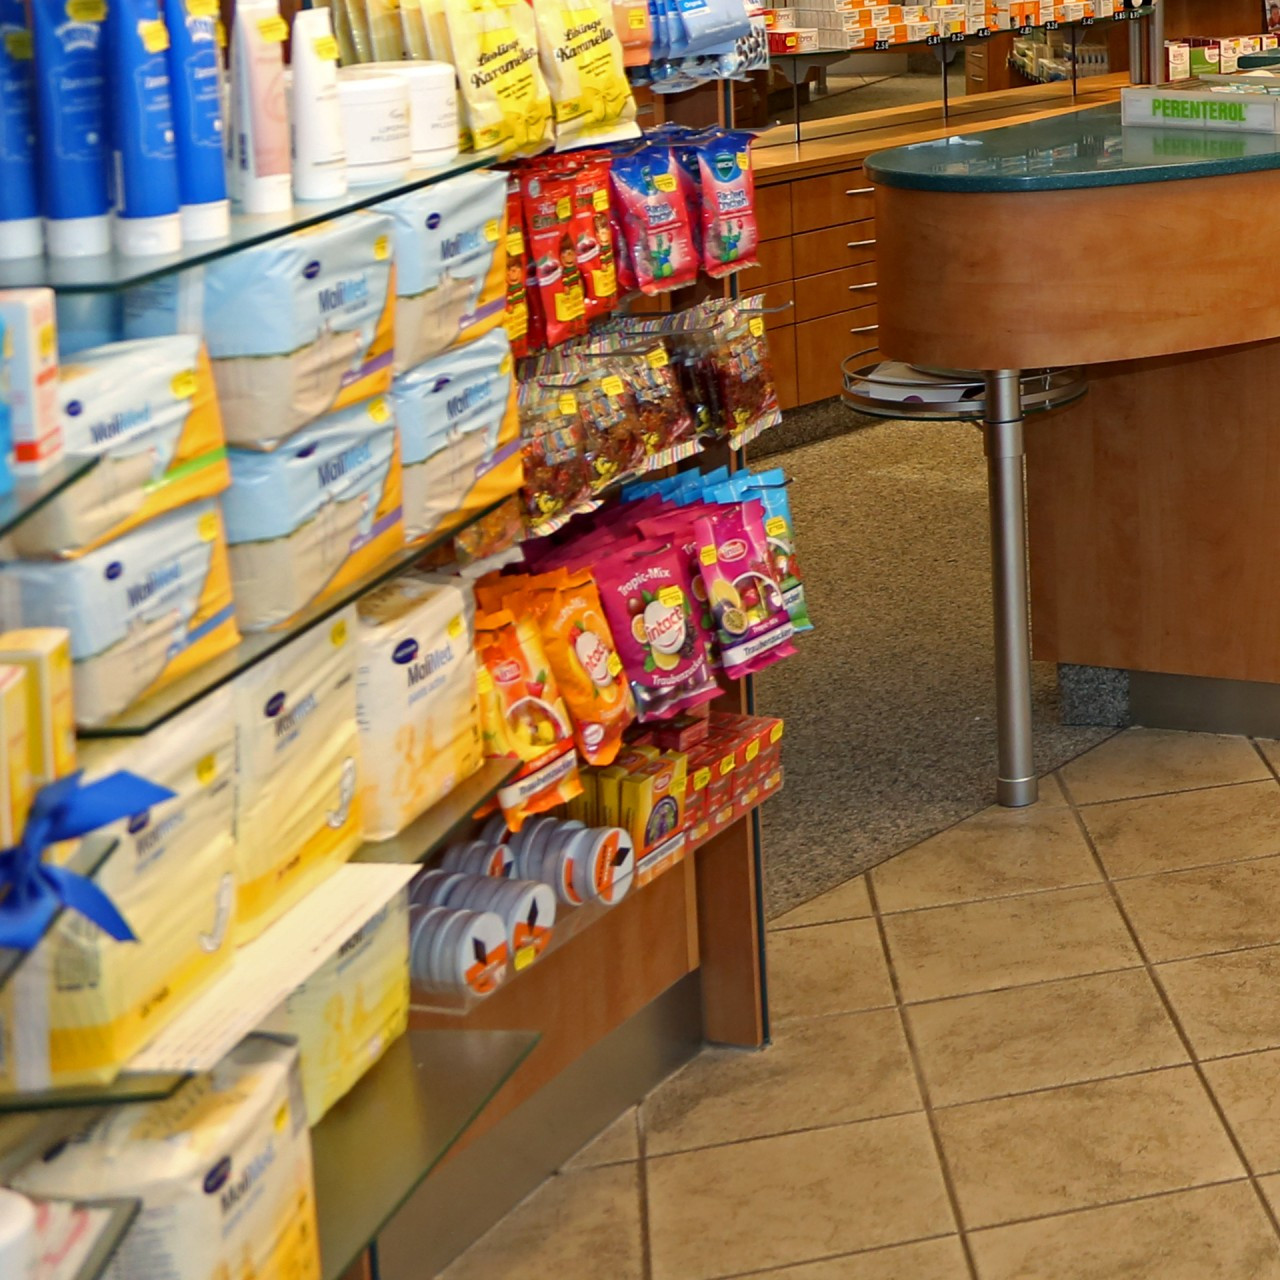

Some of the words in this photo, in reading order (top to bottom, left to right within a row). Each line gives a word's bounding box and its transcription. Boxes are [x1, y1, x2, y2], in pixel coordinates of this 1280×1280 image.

[1151, 100, 1247, 121] PERENTEROL
[617, 567, 671, 597] Tropic-Mix
[645, 606, 684, 641] intact
[743, 627, 792, 656] Traubenzucker
[407, 642, 454, 689] MoliMed
